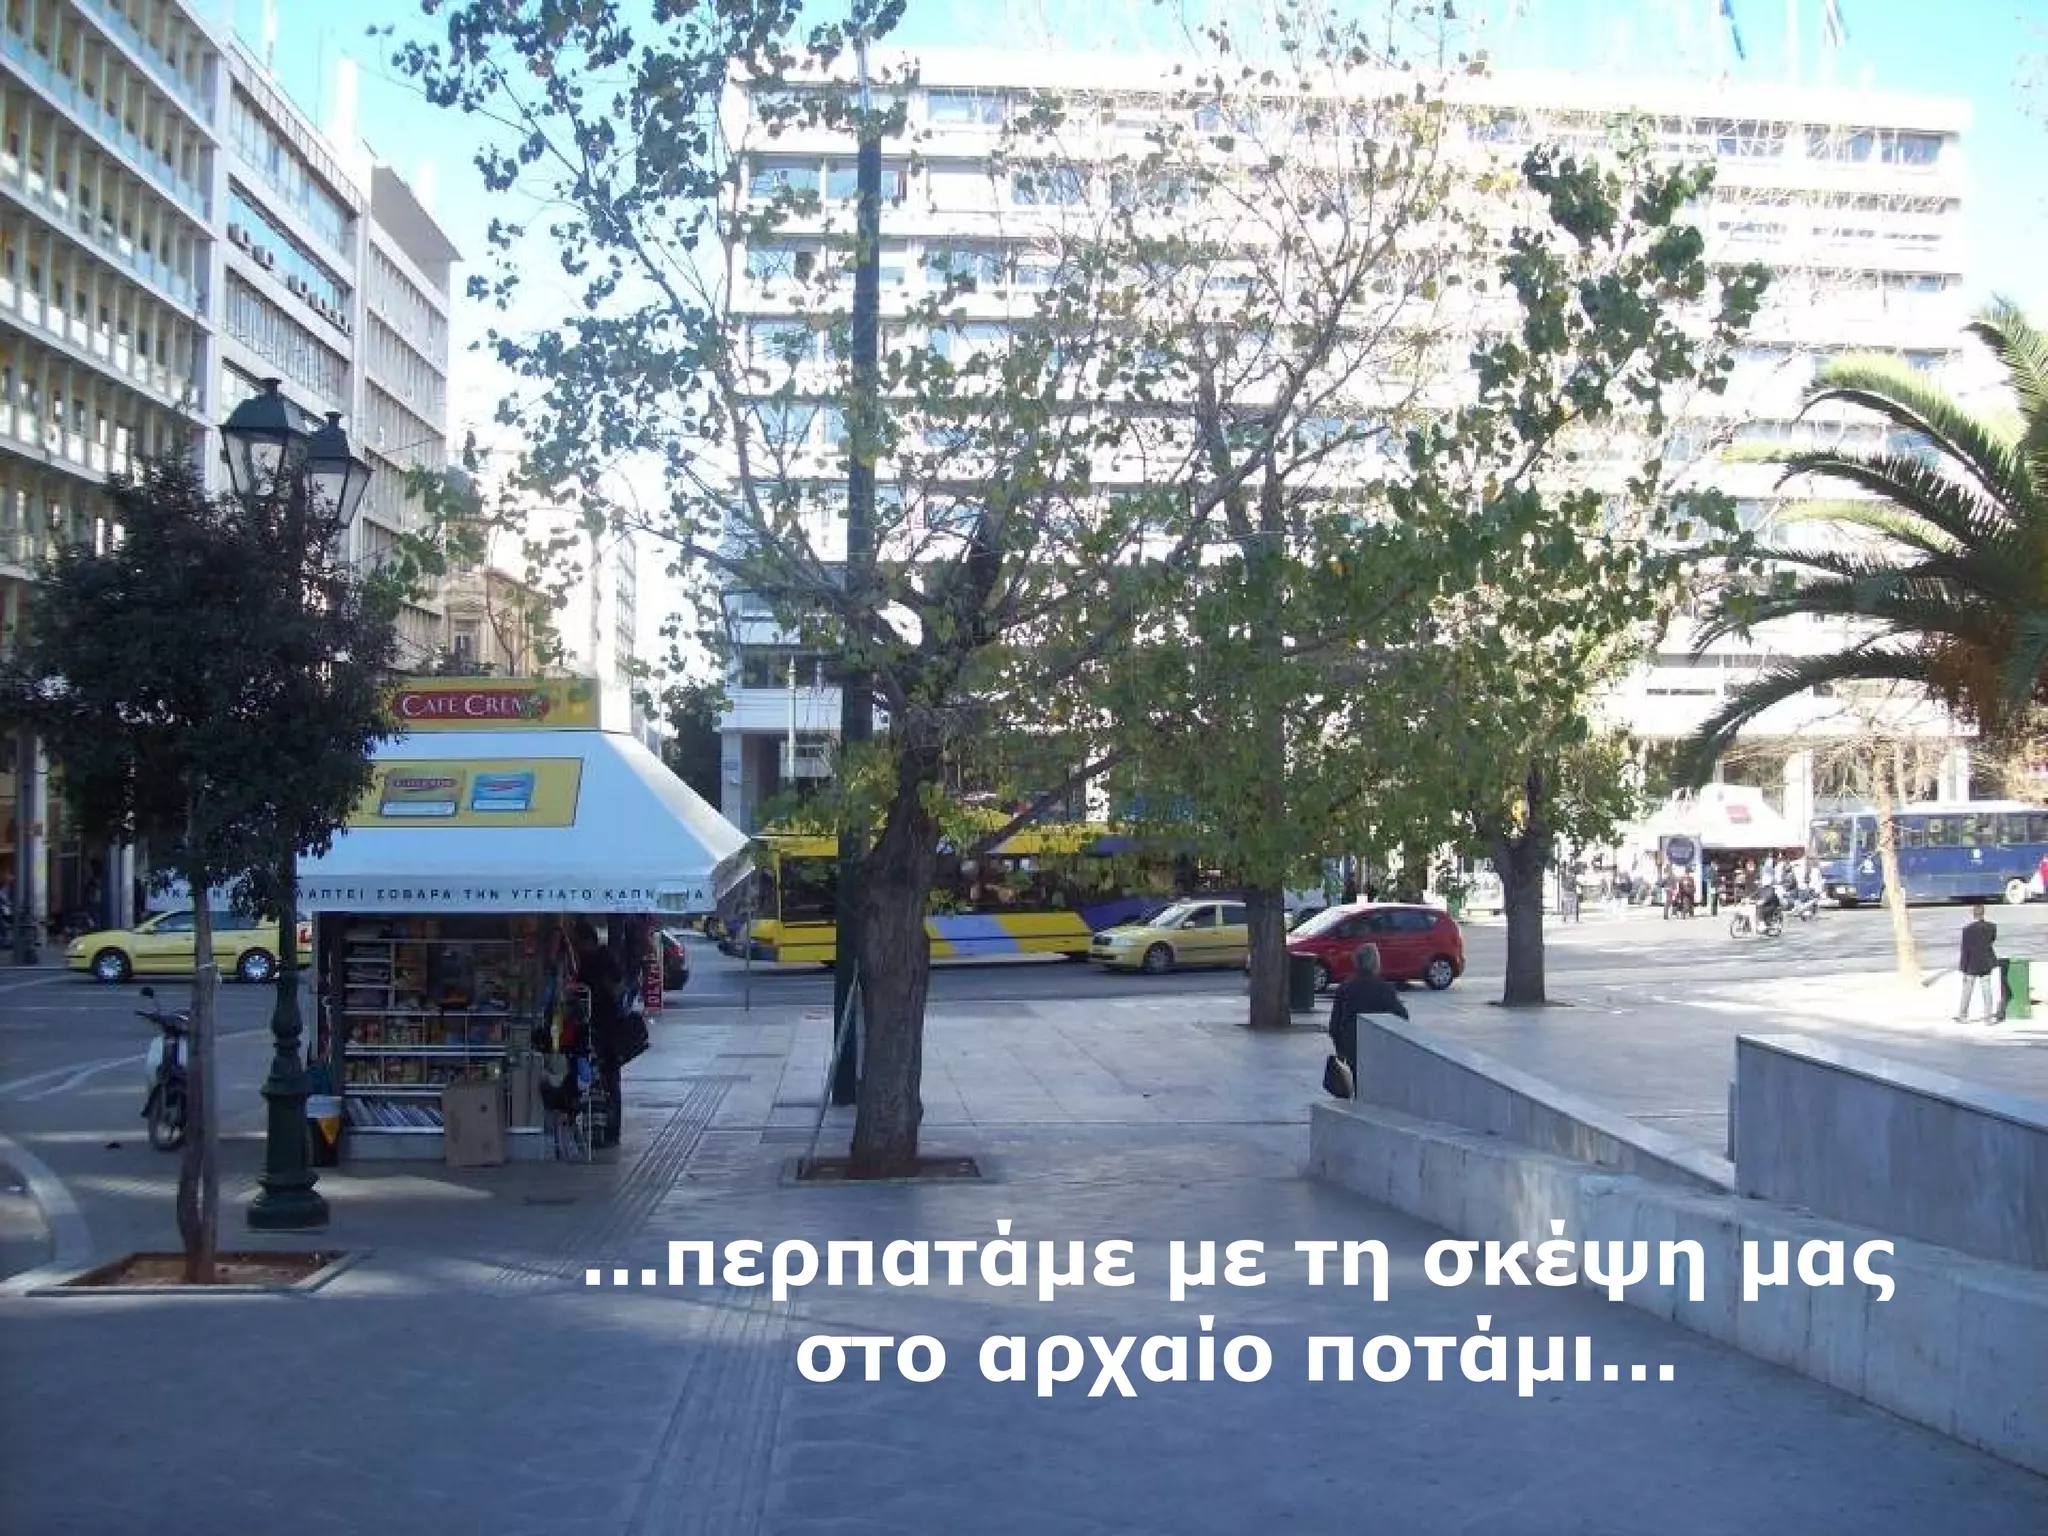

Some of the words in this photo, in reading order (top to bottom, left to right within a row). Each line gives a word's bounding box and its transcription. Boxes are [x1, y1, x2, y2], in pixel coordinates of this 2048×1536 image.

[402, 694, 458, 716] CAFE
[465, 694, 537, 716] CREM
[295, 887, 364, 901] ΛΑΠΤΕΙ
[376, 887, 452, 901] ΣΟΒΑΡΑ
[464, 887, 500, 901] ΤΗΝ
